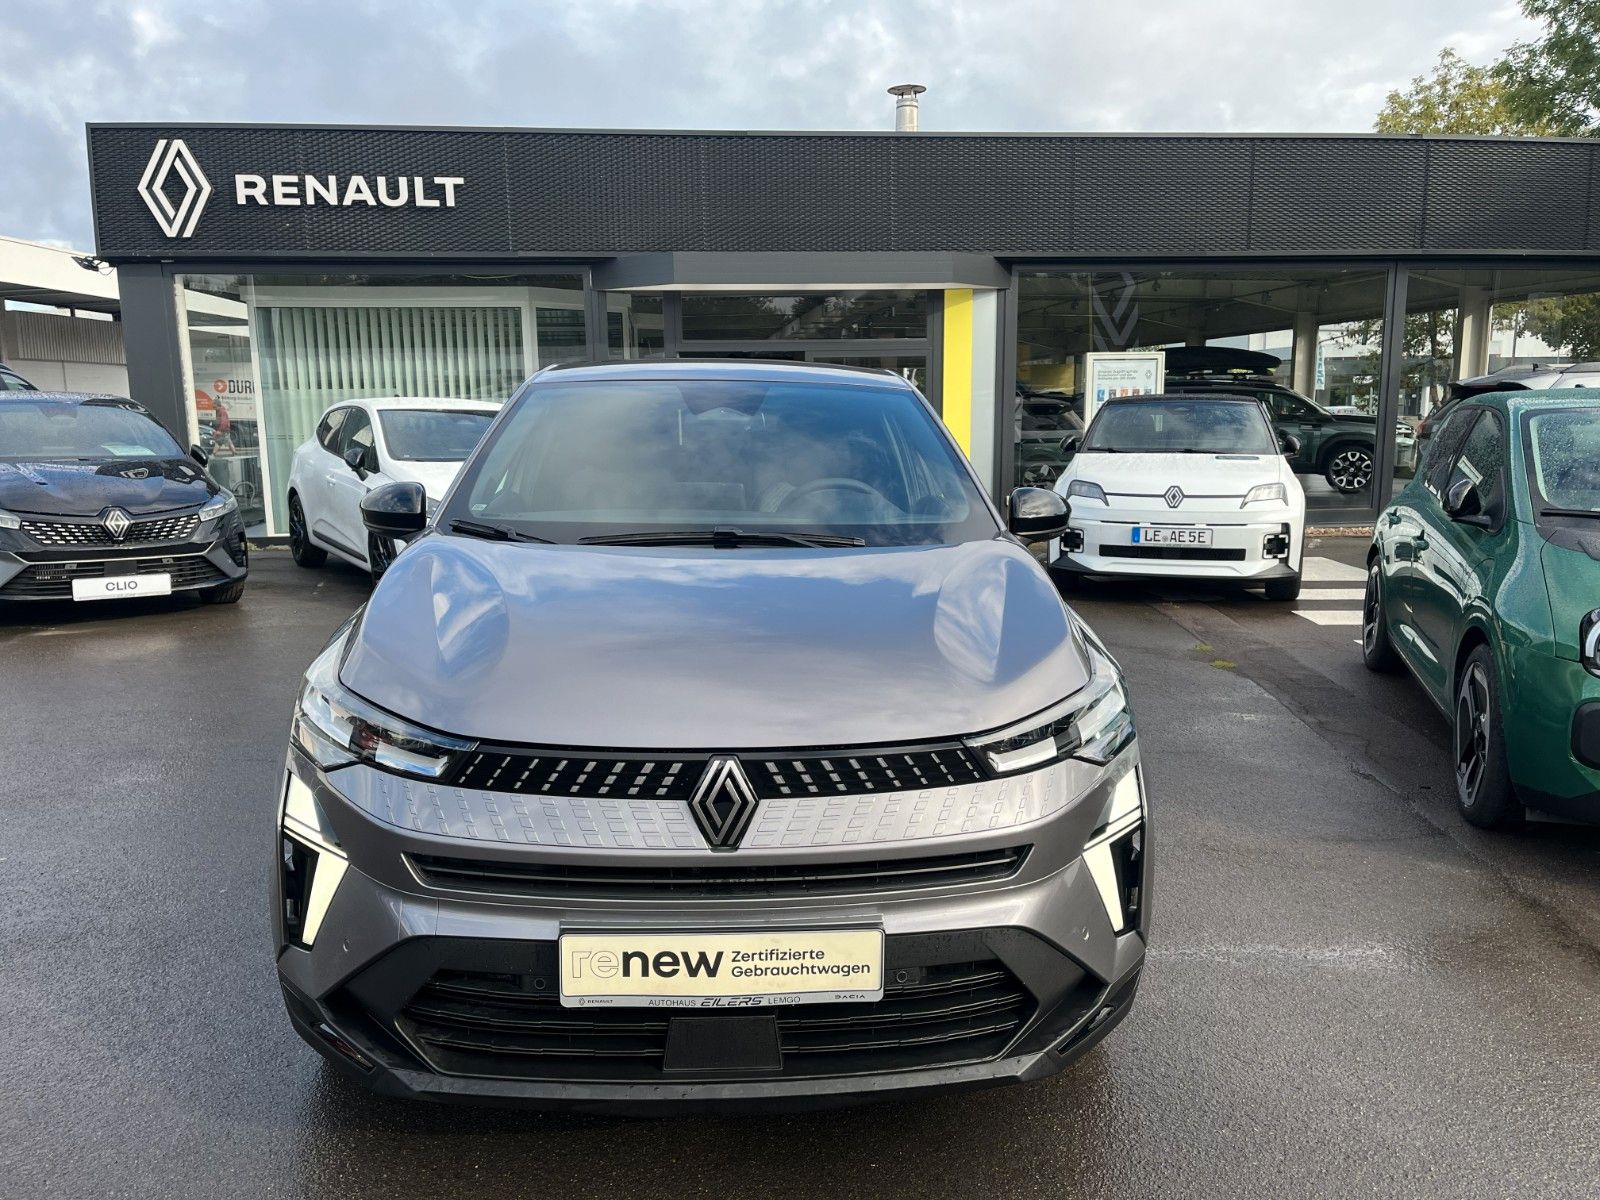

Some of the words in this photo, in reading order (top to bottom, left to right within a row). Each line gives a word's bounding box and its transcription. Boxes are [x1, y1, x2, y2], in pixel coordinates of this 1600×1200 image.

[234, 174, 465, 207] RENAULT
[1144, 529, 1161, 542] LE
[105, 580, 138, 591] CLIO
[731, 948, 825, 963] Zertifizierte
[571, 950, 724, 979] renew
[731, 963, 871, 978] Gebrauchtwagen
[648, 998, 696, 1007] AUTOHAUS
[699, 996, 764, 1007] EILERS
[768, 995, 801, 1005] LEMGO
